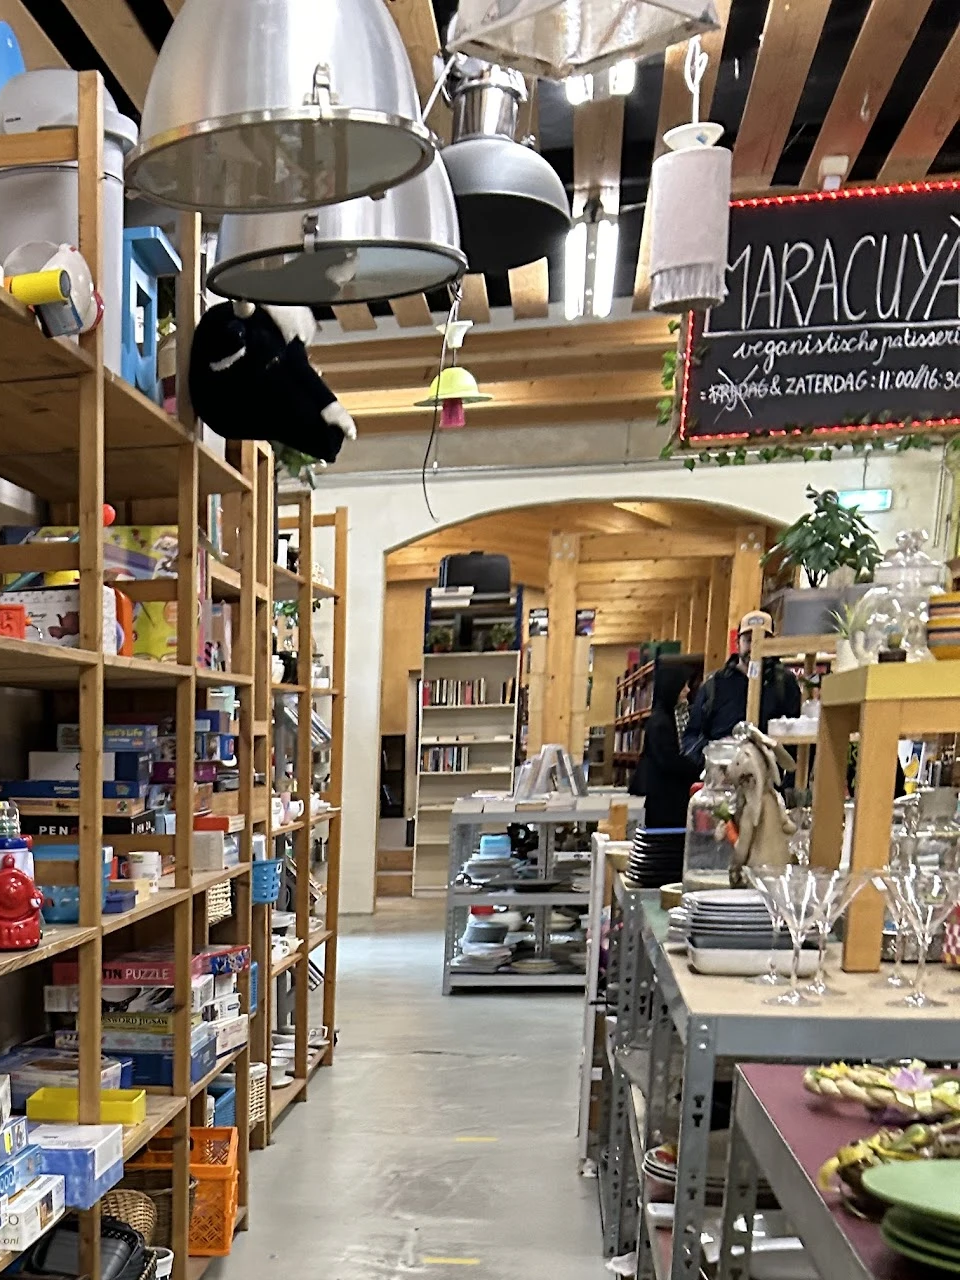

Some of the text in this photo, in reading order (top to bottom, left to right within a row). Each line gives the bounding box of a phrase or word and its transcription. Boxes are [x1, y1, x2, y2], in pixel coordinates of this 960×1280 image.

[732, 327, 960, 375] veganistische patisseri
[769, 374, 782, 396] &
[125, 967, 170, 980] PUZZLE
[102, 1017, 138, 1025] SWORD
